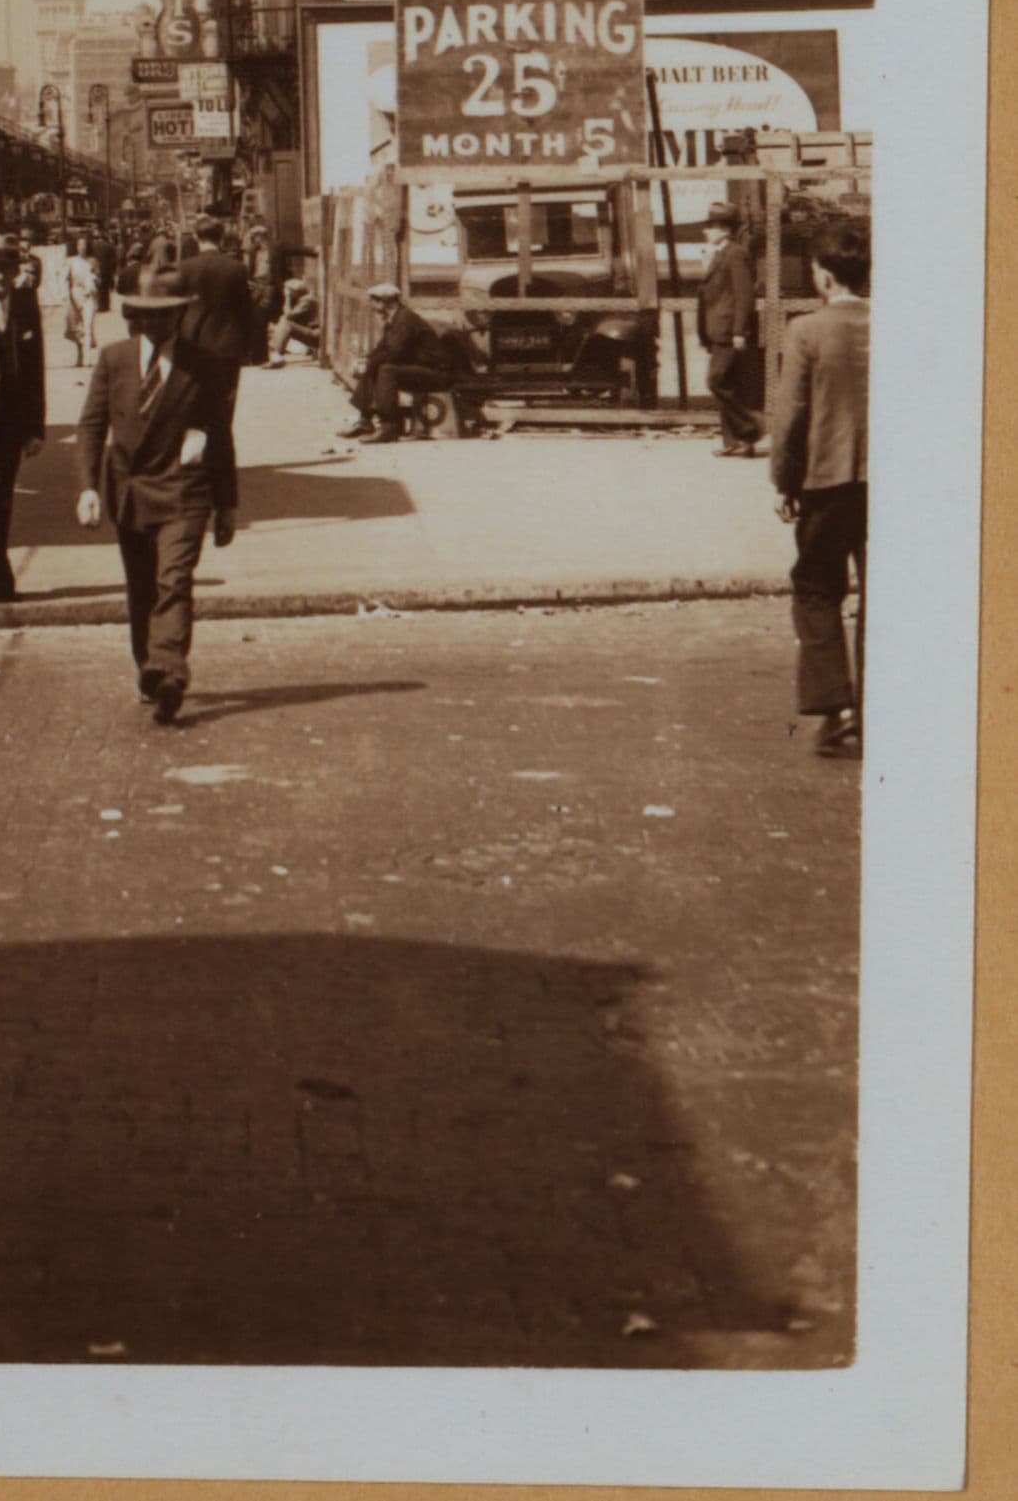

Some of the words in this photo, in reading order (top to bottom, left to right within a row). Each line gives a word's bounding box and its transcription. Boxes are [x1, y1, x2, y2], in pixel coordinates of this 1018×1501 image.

[403, 0, 636, 64] PARKING
[711, 65, 769, 83] BEER
[422, 132, 565, 156] MONTH
